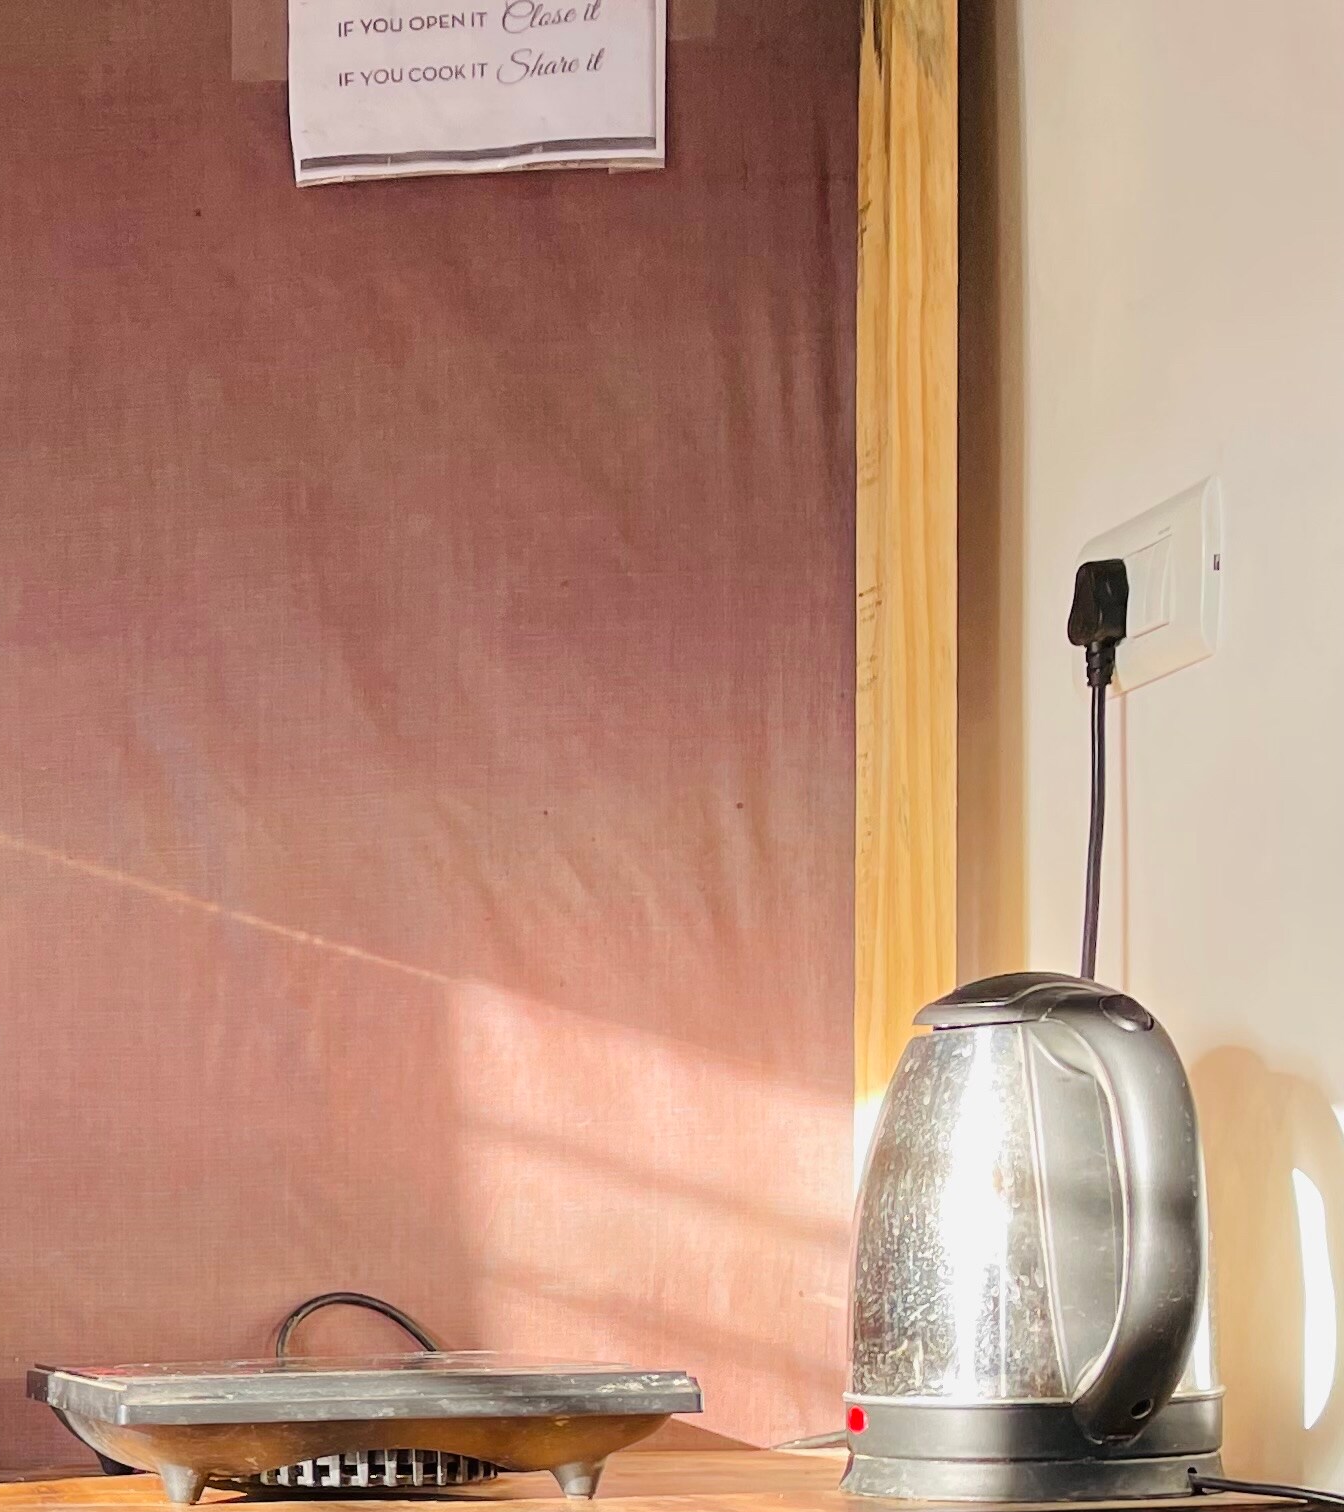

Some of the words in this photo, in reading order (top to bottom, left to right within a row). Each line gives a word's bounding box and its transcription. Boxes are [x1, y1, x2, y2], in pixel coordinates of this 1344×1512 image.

[338, 21, 354, 38] IF
[360, 18, 403, 35] YOU
[409, 12, 465, 31] OPEN
[471, 11, 488, 28] IT
[502, 0, 577, 34] Close
[338, 72, 354, 87] IF
[360, 68, 404, 86] YOU
[408, 64, 466, 83] COOK
[472, 62, 488, 79] IT
[496, 48, 580, 84] Share
[586, 48, 606, 72] it
